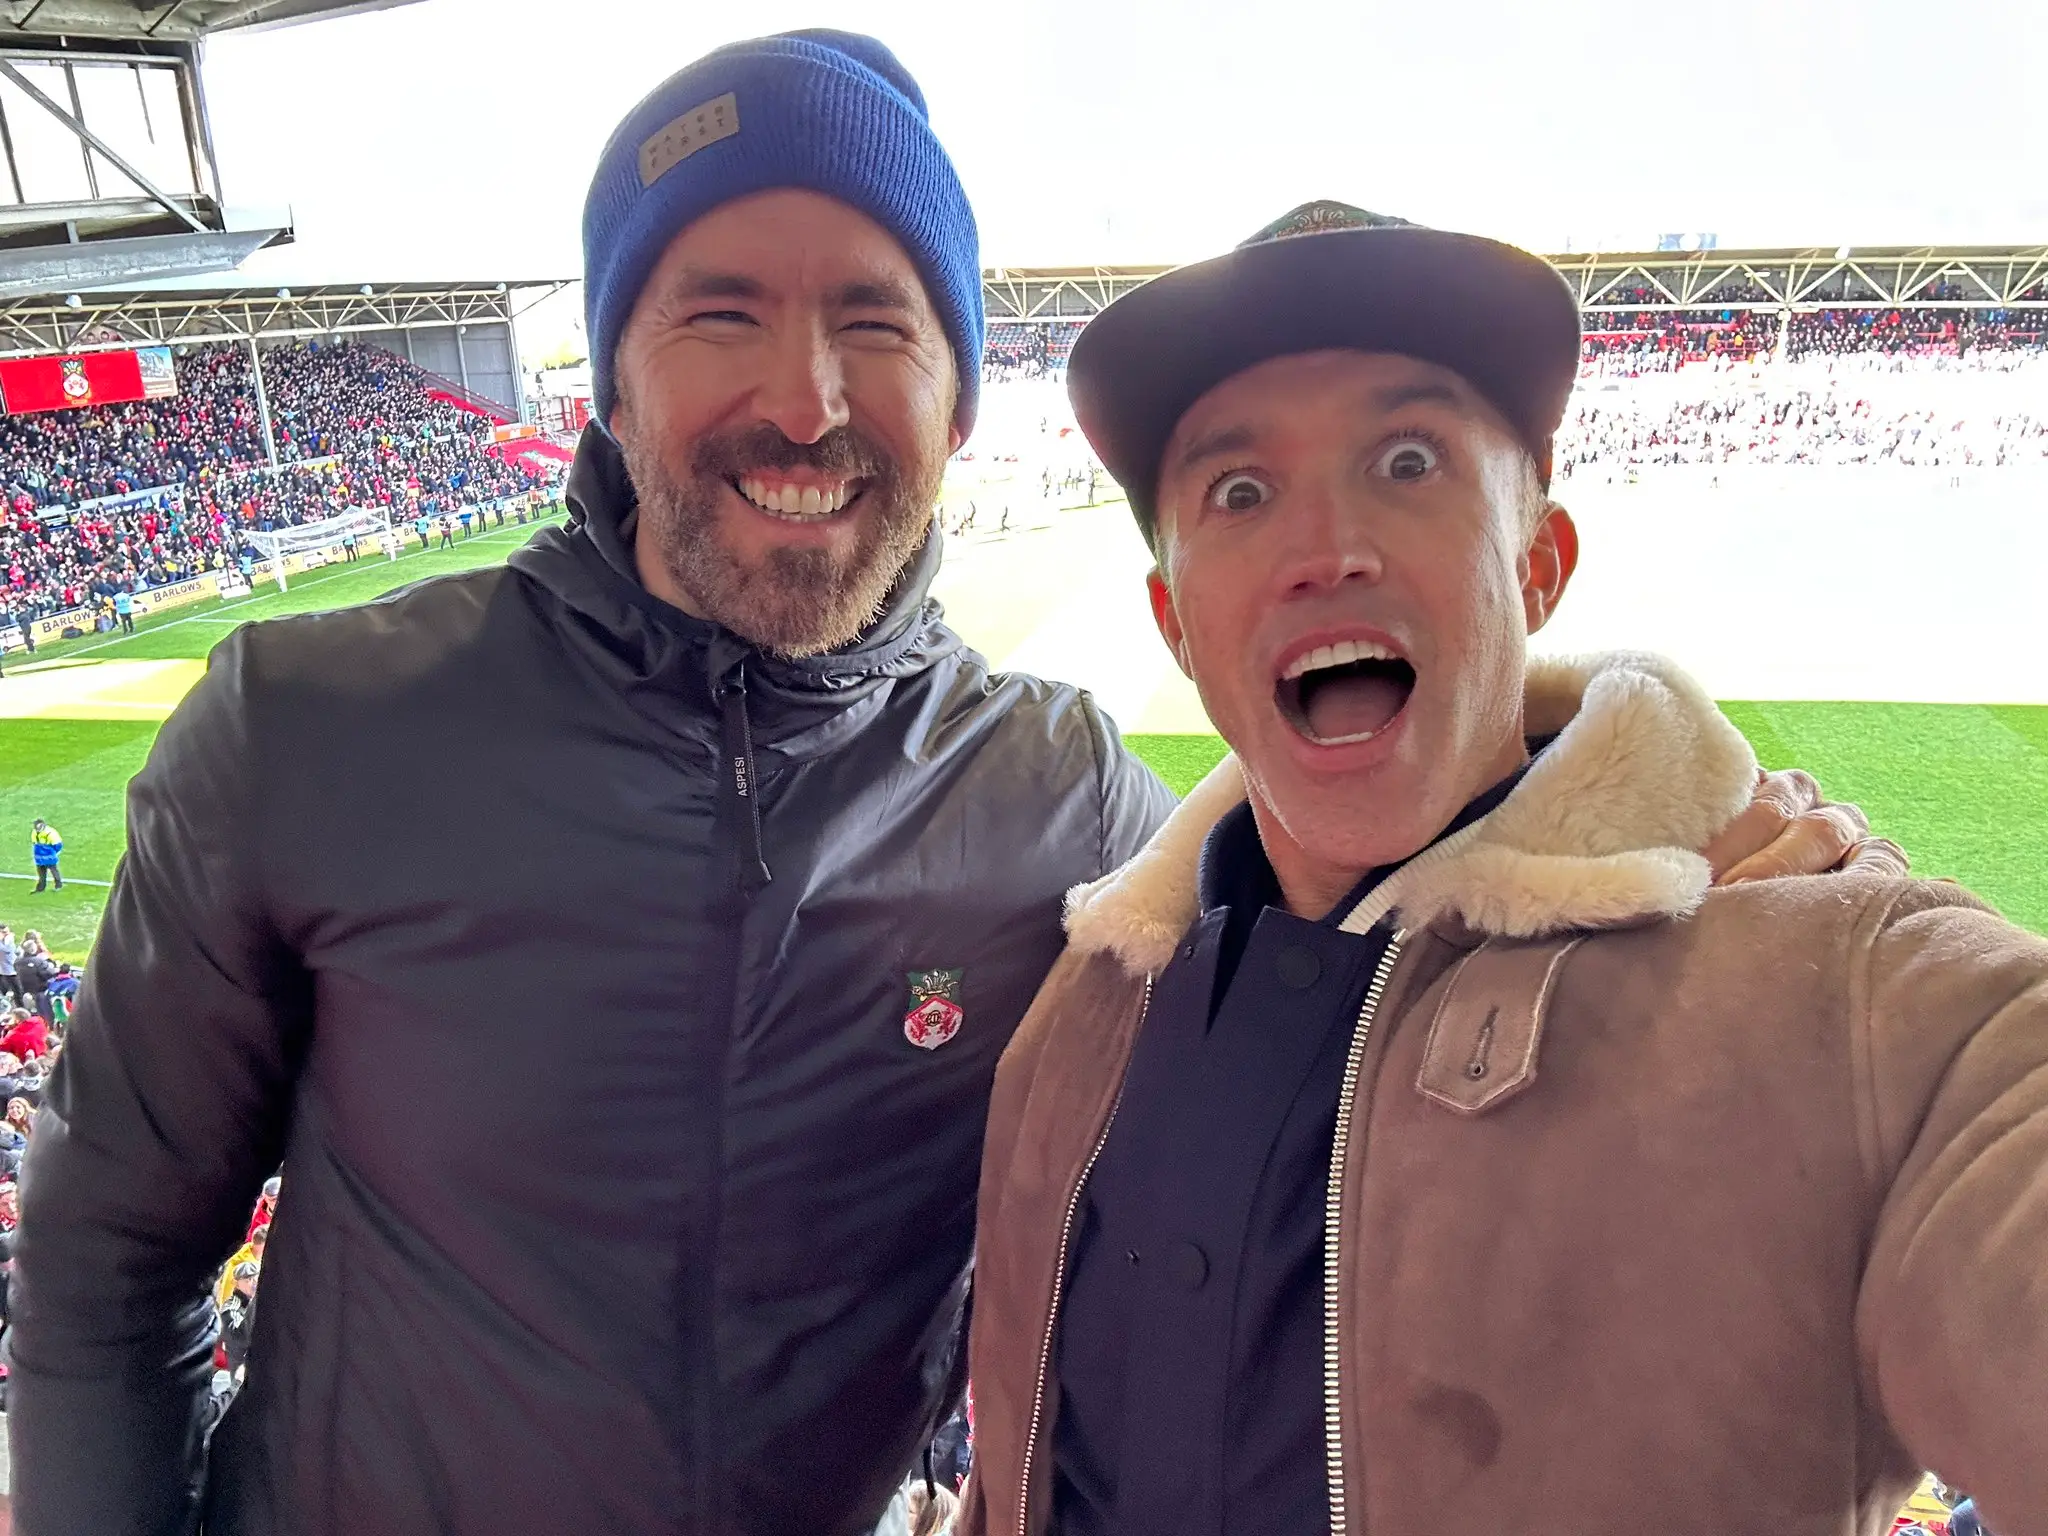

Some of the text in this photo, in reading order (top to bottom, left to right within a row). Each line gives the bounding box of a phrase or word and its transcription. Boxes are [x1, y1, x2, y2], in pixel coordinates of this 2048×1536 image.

[153, 581, 202, 602] BARLOWS
[42, 608, 95, 633] BARLOW
[734, 757, 748, 796] ASPESI
